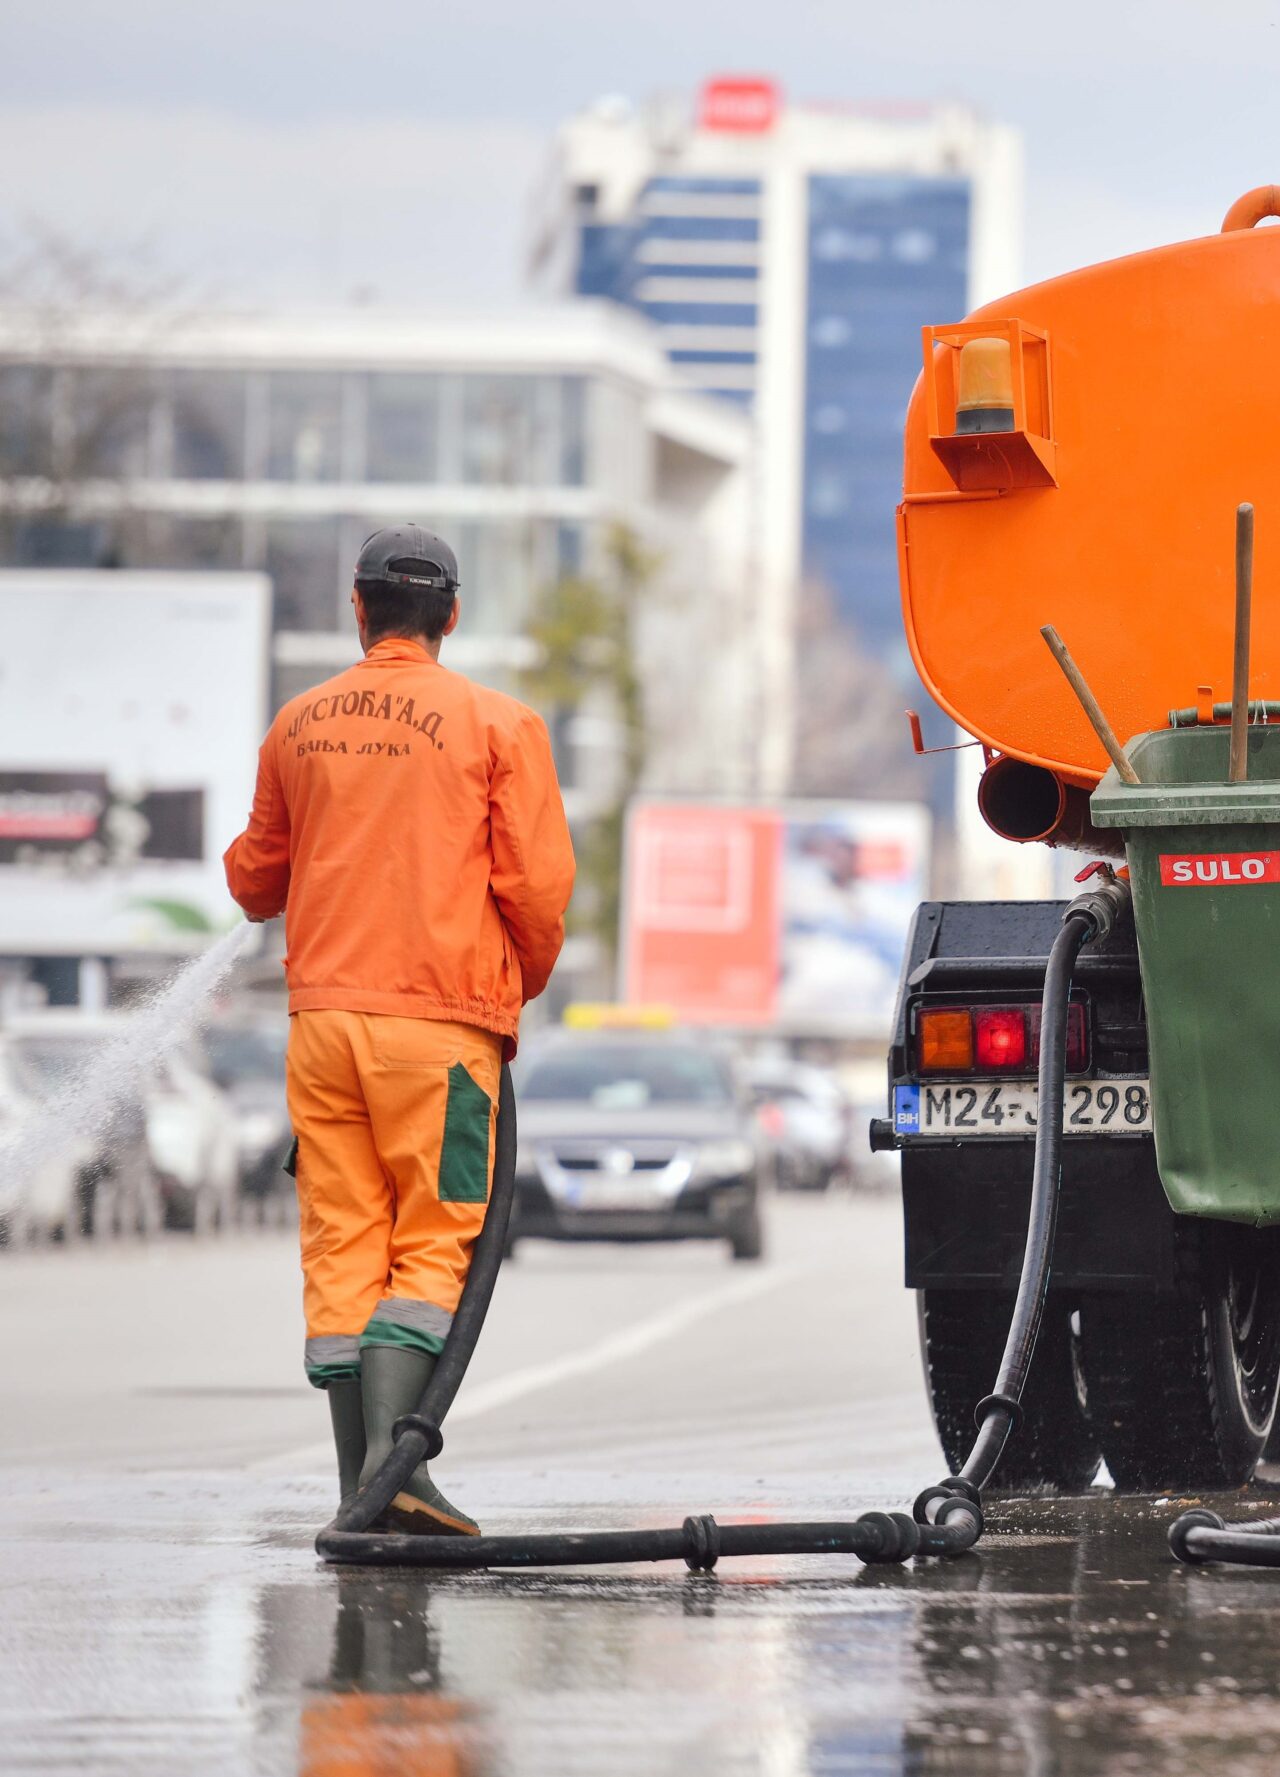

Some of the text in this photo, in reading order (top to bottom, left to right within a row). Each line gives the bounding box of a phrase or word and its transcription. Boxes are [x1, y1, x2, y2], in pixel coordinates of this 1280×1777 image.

[297, 739, 411, 757] БАЊА ЛУКА
[897, 1112, 919, 1125] BIH
